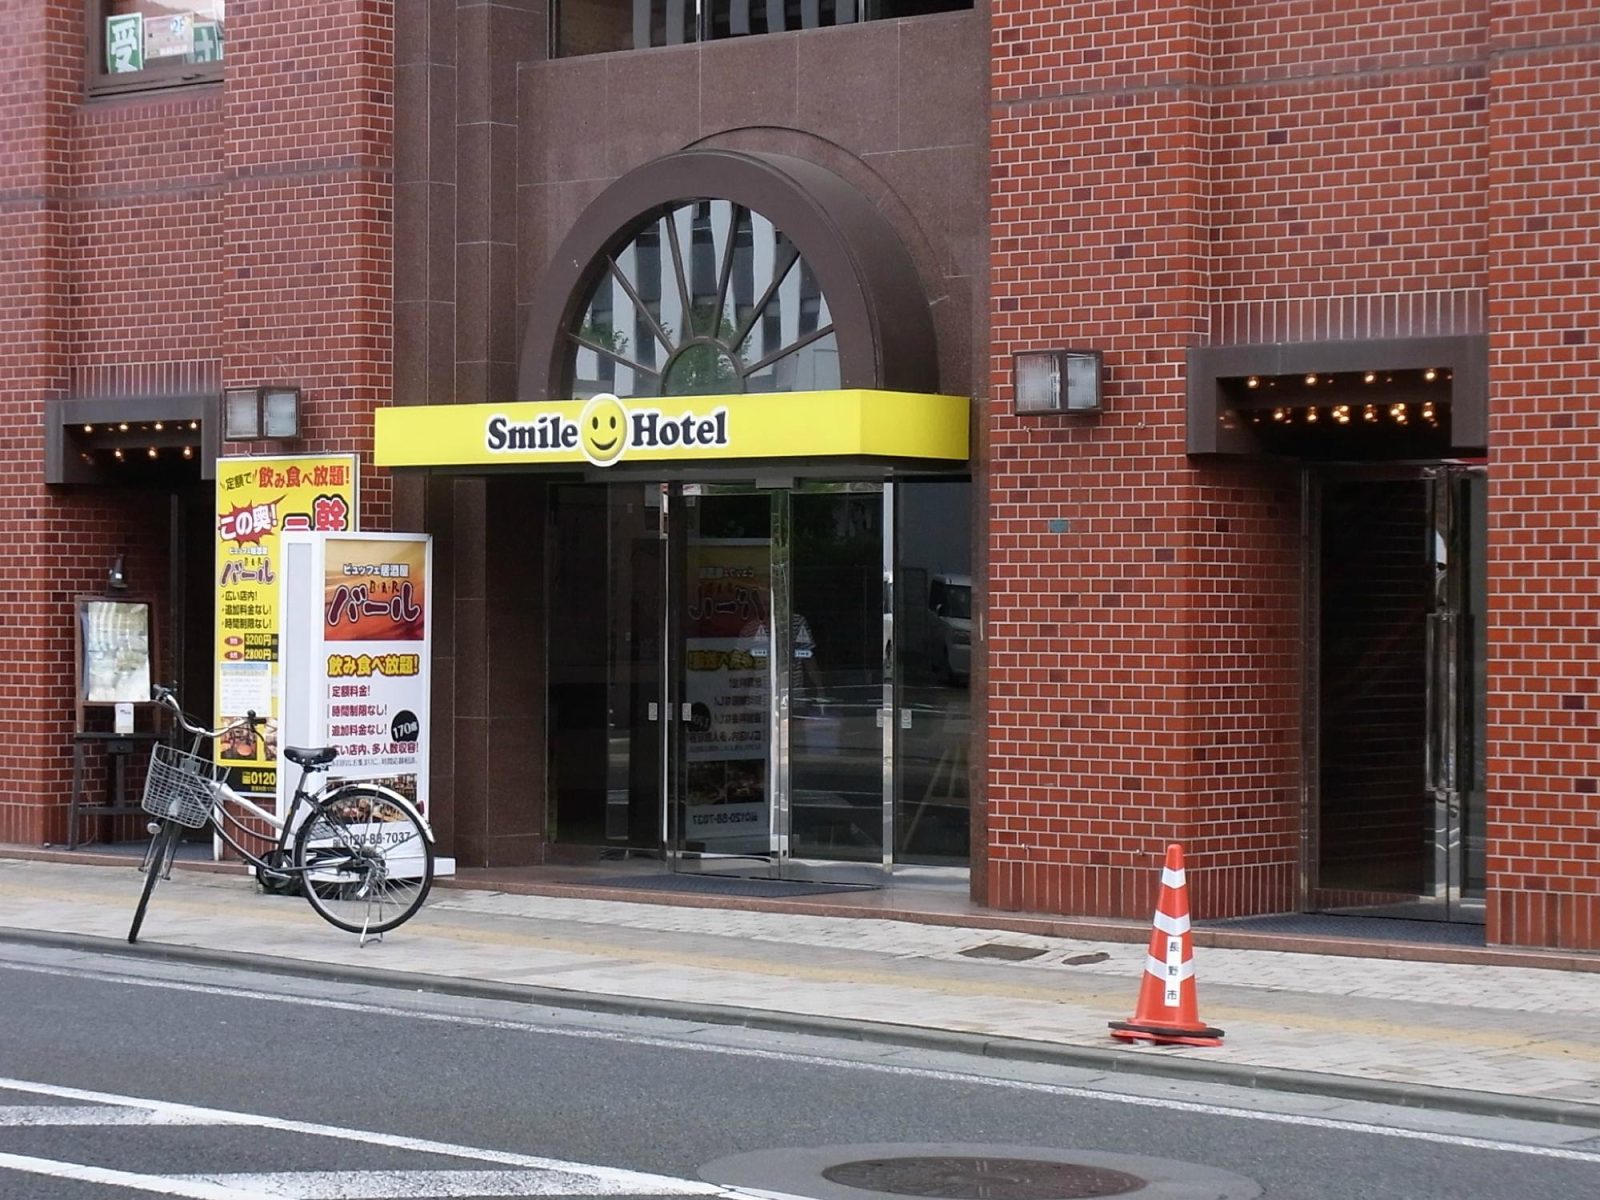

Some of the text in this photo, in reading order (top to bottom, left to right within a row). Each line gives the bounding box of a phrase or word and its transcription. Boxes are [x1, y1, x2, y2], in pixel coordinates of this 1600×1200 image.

[111, 19, 138, 73] 受
[488, 411, 728, 450] Smile Hotel
[258, 464, 350, 489] 飲み食べ放題!
[220, 502, 277, 541] この奥!
[220, 557, 275, 587] バール
[327, 581, 421, 626] バール
[328, 653, 420, 677] 飲み食べ放題!
[332, 685, 370, 698] 定額料金!
[332, 704, 387, 717] 時間制限なし!
[332, 724, 387, 737] 追加料金なし!
[250, 771, 276, 785] 0120
[1167, 941, 1179, 1000] 長野市
